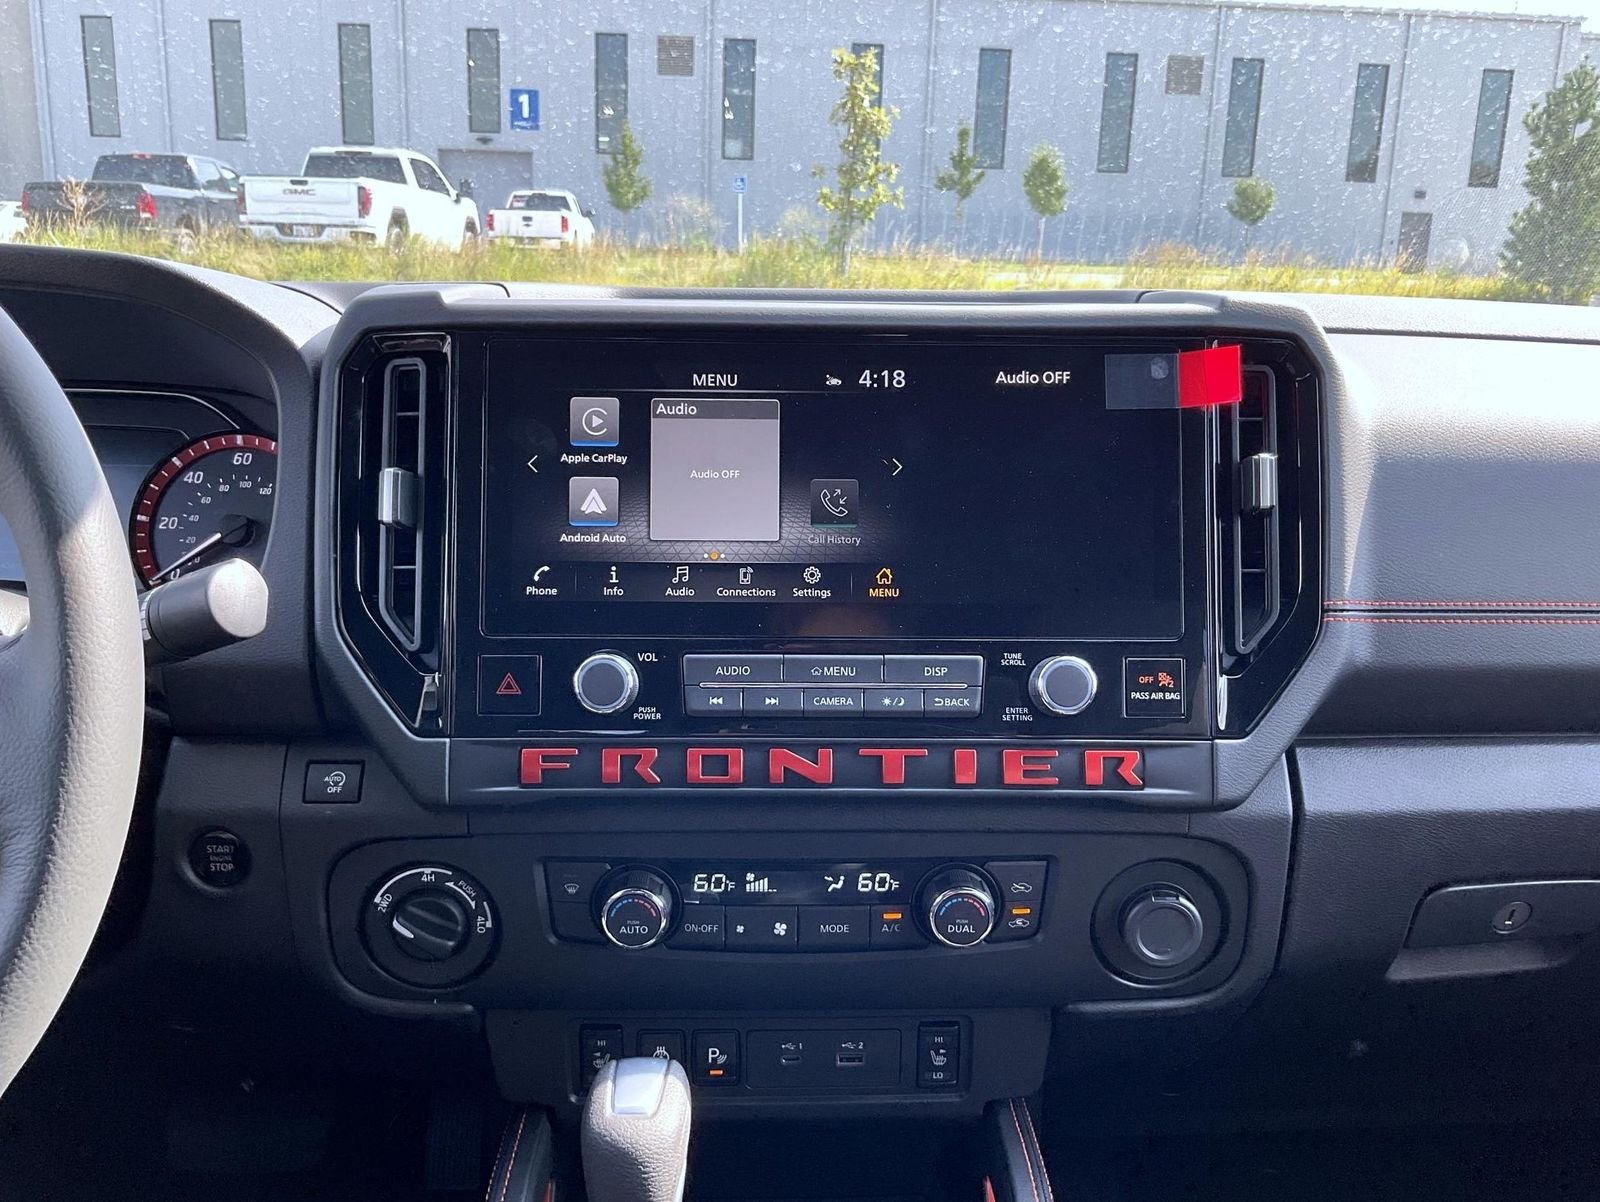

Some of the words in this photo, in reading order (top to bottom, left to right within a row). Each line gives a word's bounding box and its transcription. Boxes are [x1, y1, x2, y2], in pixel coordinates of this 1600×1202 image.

[518, 93, 530, 119] 1
[283, 188, 317, 196] GMC
[692, 373, 738, 387] MENU
[858, 369, 907, 388] 4:18
[995, 370, 1039, 384] Audio
[1042, 371, 1071, 384] OFF
[656, 402, 698, 415] Audio
[233, 452, 252, 465] 60
[560, 453, 590, 466] Apple
[591, 453, 628, 466] CarPlay
[183, 471, 204, 485] 40
[690, 468, 719, 479] Audio
[721, 469, 741, 479] OFF
[158, 516, 179, 530] 20
[559, 532, 600, 544] Android
[602, 532, 627, 544] Auto
[807, 534, 825, 545] Call
[827, 534, 862, 547] History
[525, 585, 558, 597] Phone
[603, 586, 624, 597] Info
[665, 586, 695, 597] Audio
[716, 586, 776, 597] Connections
[792, 586, 832, 600] Settings
[869, 587, 900, 598] MENU
[637, 652, 659, 662] VOL
[715, 665, 751, 676] AUDIO
[823, 666, 857, 677] MENU
[923, 666, 948, 677] DISP
[1138, 675, 1154, 684] OFF
[813, 696, 854, 706] CAMERA
[1130, 691, 1150, 700] PASS
[1150, 692, 1164, 700] AIR
[1164, 692, 1181, 700] BAG
[944, 697, 970, 707] BACK
[633, 712, 662, 721] POWER
[1005, 707, 1029, 715] ENTER
[1002, 714, 1033, 722] SETTING
[519, 746, 1145, 787] FRONTIER
[327, 786, 342, 794] OFF
[206, 844, 235, 854] START
[209, 863, 234, 872] STOP
[421, 873, 435, 883] 4H
[457, 880, 478, 898] PUSH
[377, 893, 393, 913] 2WD
[476, 915, 486, 934] 4LO
[619, 925, 649, 935] AUTO
[819, 924, 850, 934] MODE
[881, 923, 902, 933] A/C
[947, 924, 976, 934] DUAL
[858, 1041, 864, 1049] 2
[934, 1036, 944, 1044] HI
[932, 1071, 944, 1080] LO
